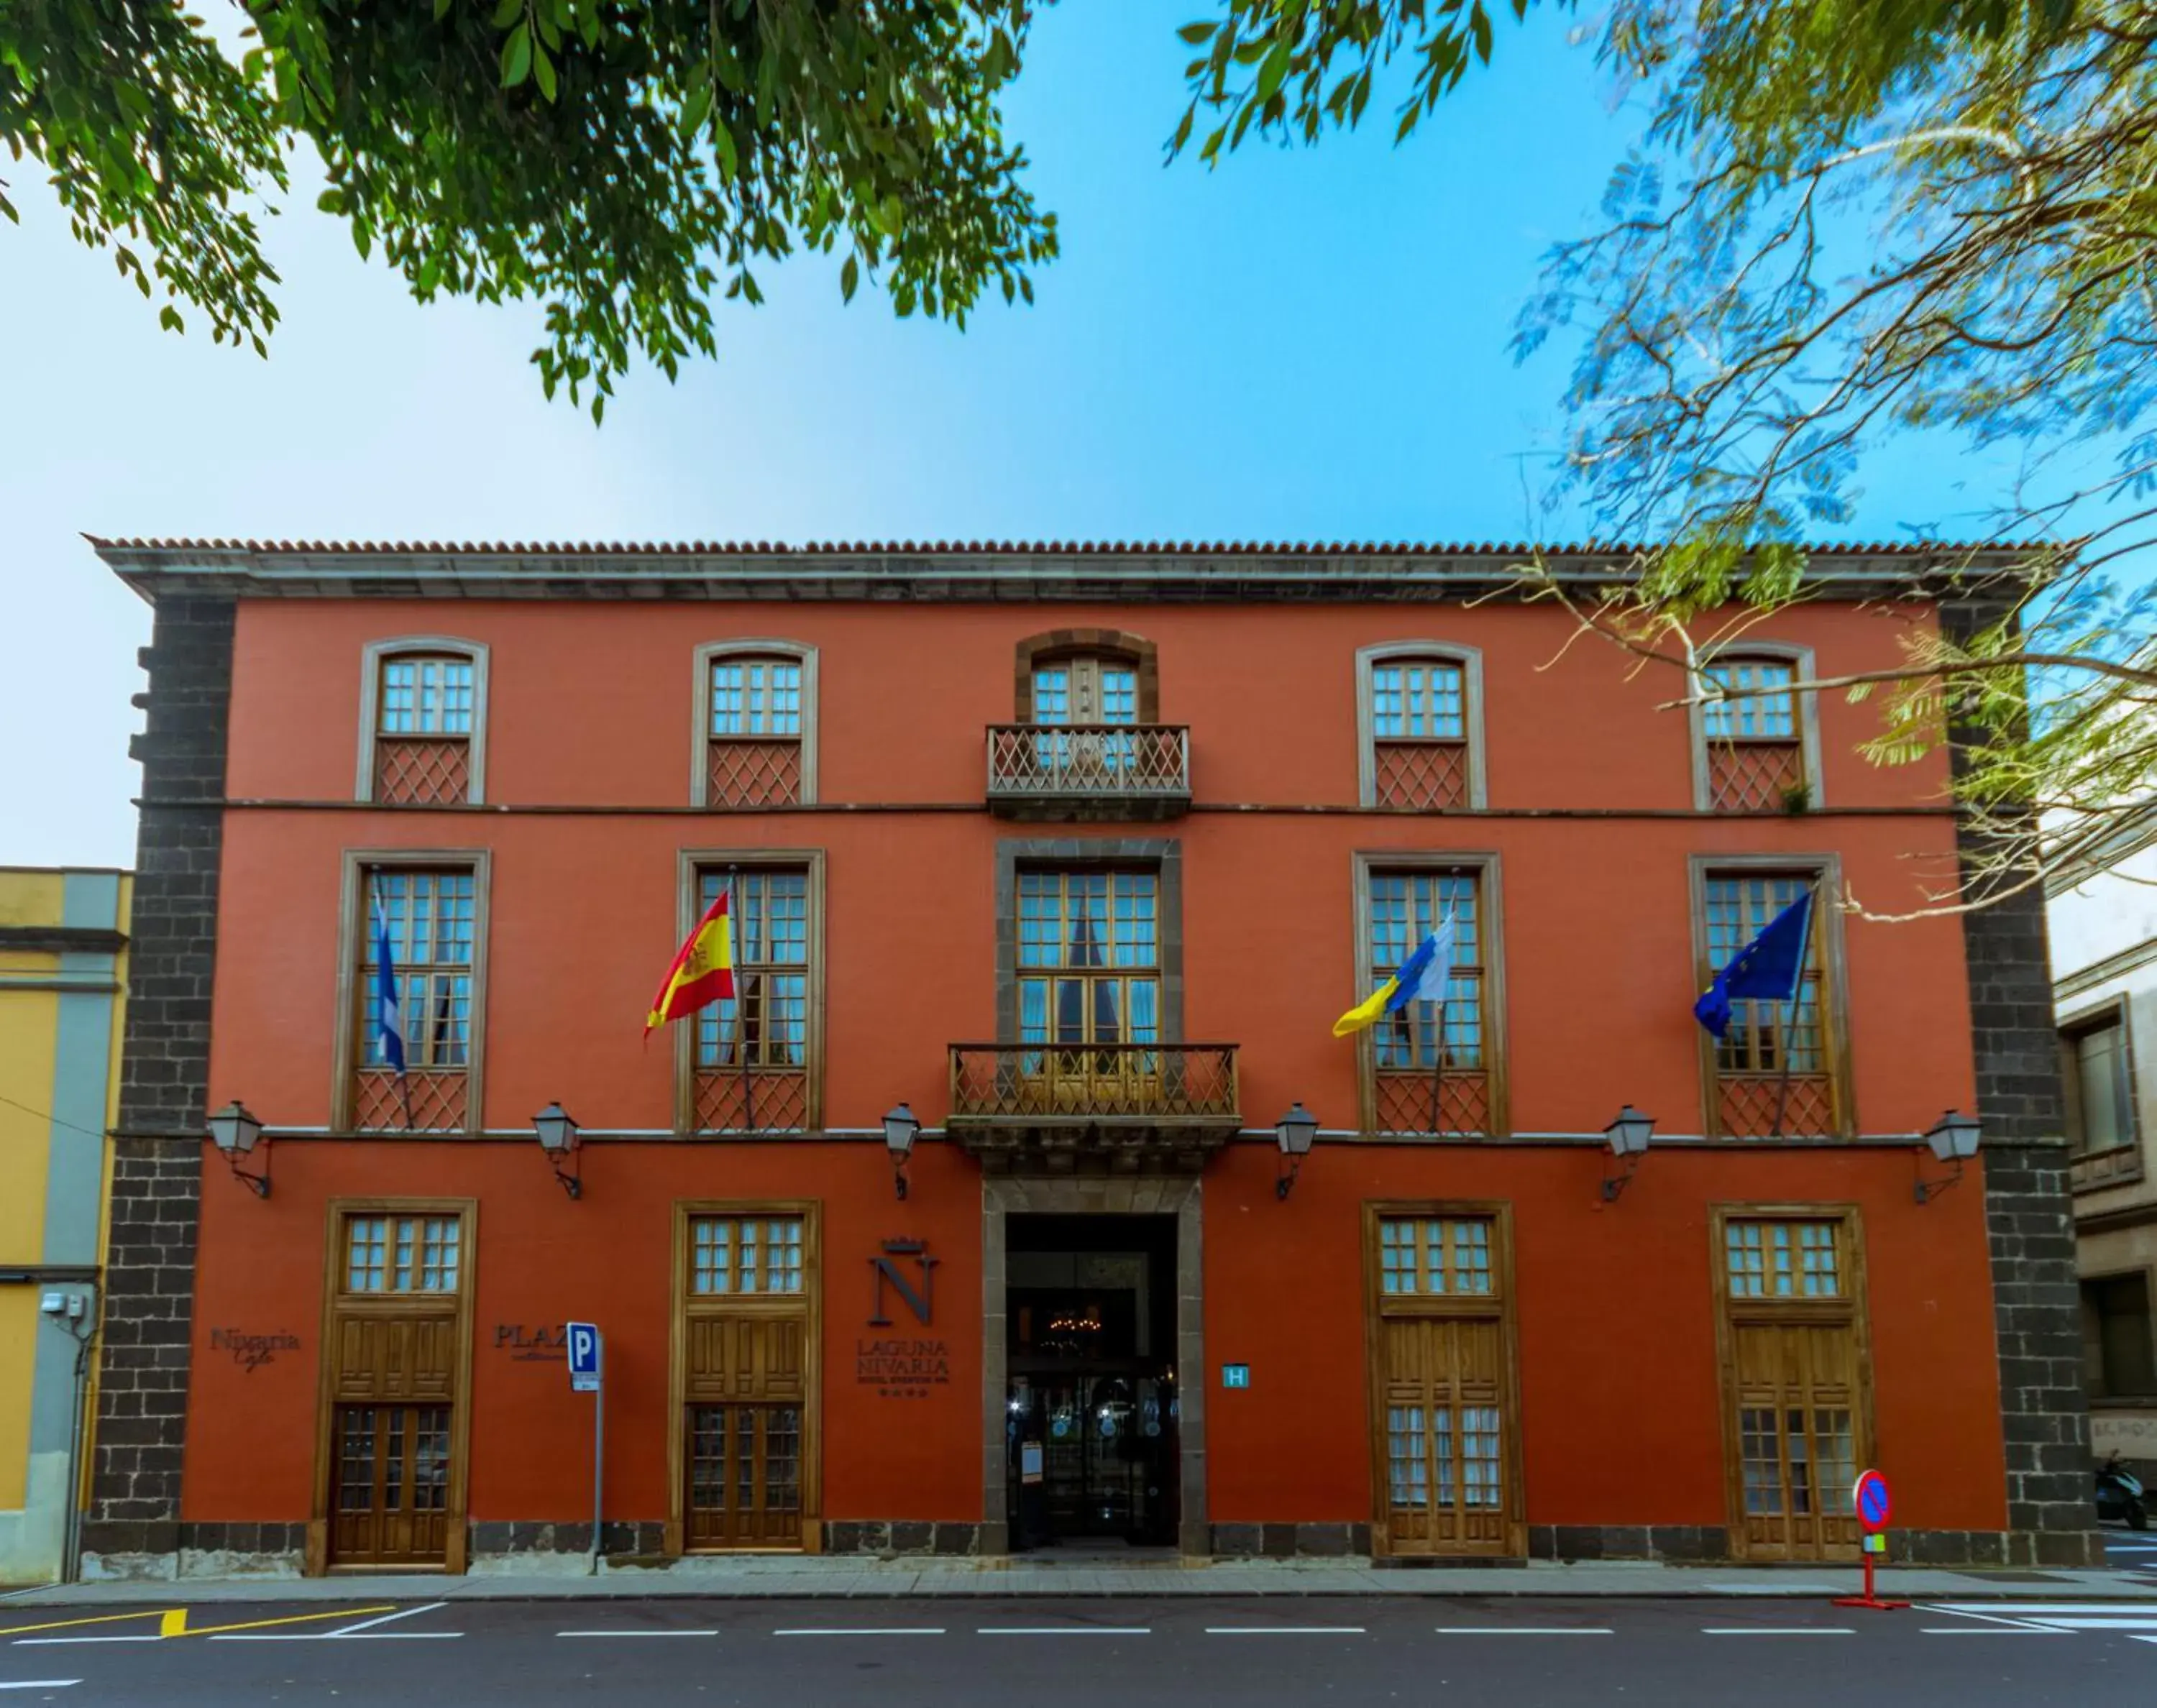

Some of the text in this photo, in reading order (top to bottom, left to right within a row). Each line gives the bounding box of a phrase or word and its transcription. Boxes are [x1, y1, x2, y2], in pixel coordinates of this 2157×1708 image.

[490, 1325, 567, 1347] PLAZ
[575, 1331, 592, 1367] P
[857, 1339, 948, 1356] LAGUNA
[857, 1357, 948, 1374] NIVARIA
[1229, 1368, 1243, 1386] H
